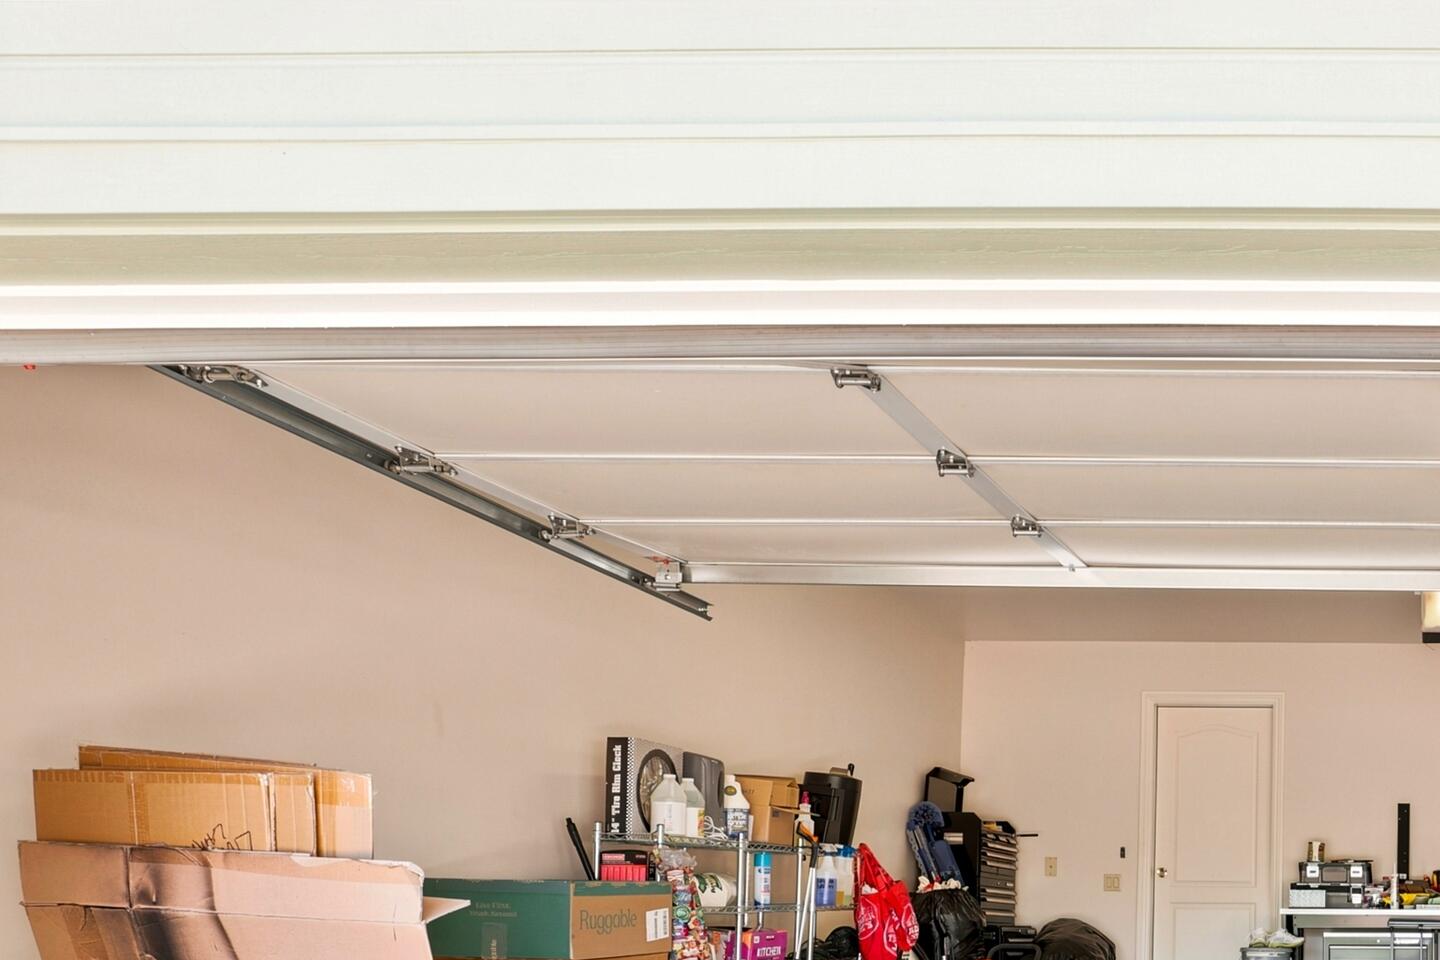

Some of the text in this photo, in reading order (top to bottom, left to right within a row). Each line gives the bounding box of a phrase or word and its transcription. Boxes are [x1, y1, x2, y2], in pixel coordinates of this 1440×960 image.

[612, 745, 622, 772] Clock
[611, 774, 621, 793] Rim
[611, 796, 621, 816] Tire
[579, 909, 637, 934] Ruggable
